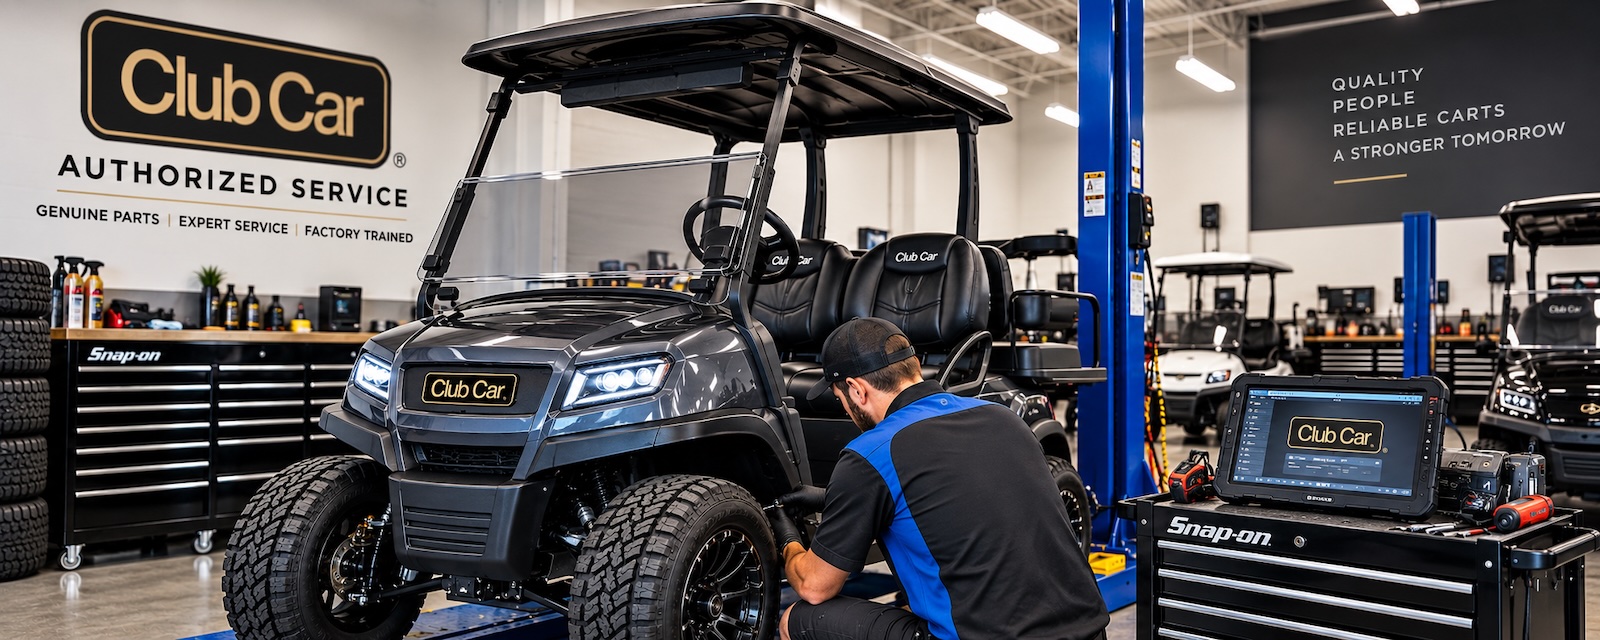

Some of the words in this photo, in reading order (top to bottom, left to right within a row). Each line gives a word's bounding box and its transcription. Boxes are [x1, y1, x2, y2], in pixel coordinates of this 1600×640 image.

[1331, 67, 1424, 92] QUALITY
[121, 48, 261, 126] Club
[269, 71, 365, 138] Car
[1333, 90, 1416, 114] PEOPLE
[1333, 113, 1428, 137] RELIABLE
[1437, 103, 1505, 124] CARTS
[1333, 149, 1345, 163] A
[1350, 137, 1445, 160] STRONGER
[1451, 121, 1566, 148] TOMORROW
[57, 153, 278, 196] AUTHORIZED
[291, 178, 408, 208] SERVICE
[36, 204, 108, 222] GENUINE
[113, 210, 160, 225] PARTS
[179, 215, 231, 230] EXPERT
[234, 219, 288, 235] SERVICE
[305, 225, 361, 240] FACTORY
[364, 229, 414, 243] TRAINED
[771, 255, 790, 266] Clu
[895, 251, 918, 263] Club
[919, 251, 939, 262] Car
[87, 346, 162, 365] Snap-on
[431, 378, 470, 398] Club
[1297, 424, 1337, 444] Club
